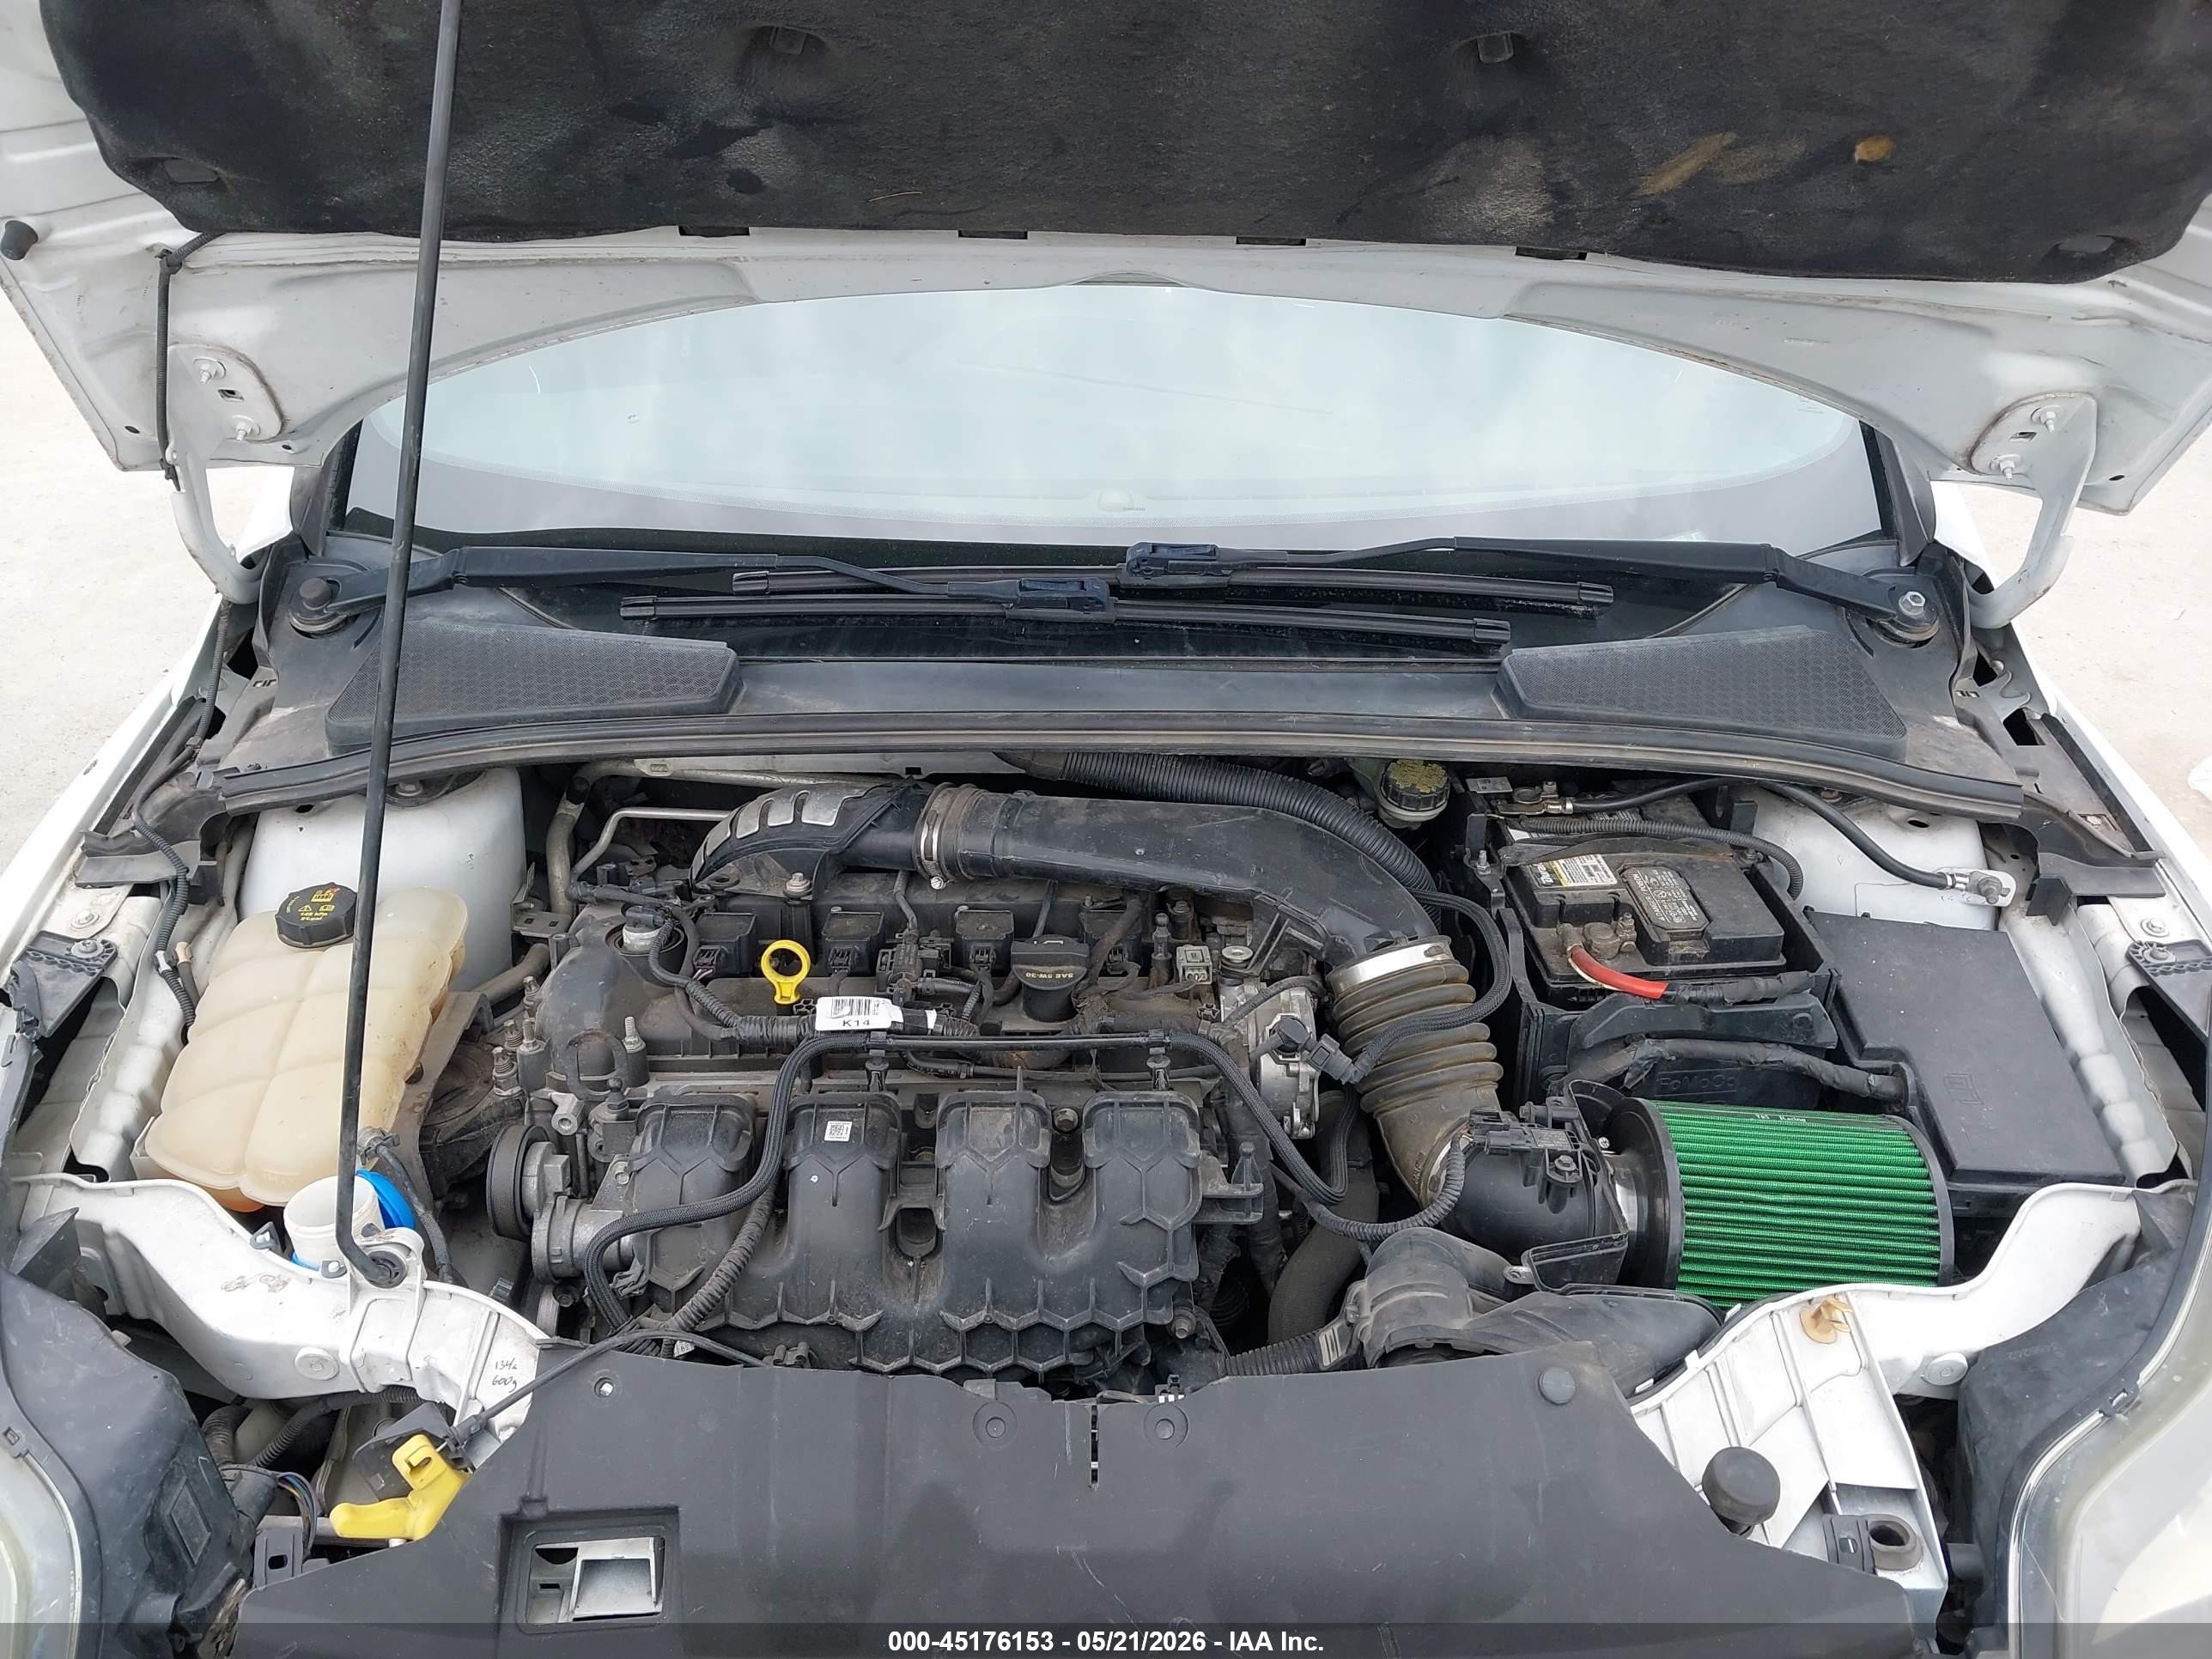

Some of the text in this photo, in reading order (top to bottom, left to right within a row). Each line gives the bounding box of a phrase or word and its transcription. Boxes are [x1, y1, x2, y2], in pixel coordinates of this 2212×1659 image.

[1532, 863, 1554, 884] Dural
[842, 1018, 871, 1027] K14
[1656, 1073, 1737, 1091] FoMoCo
